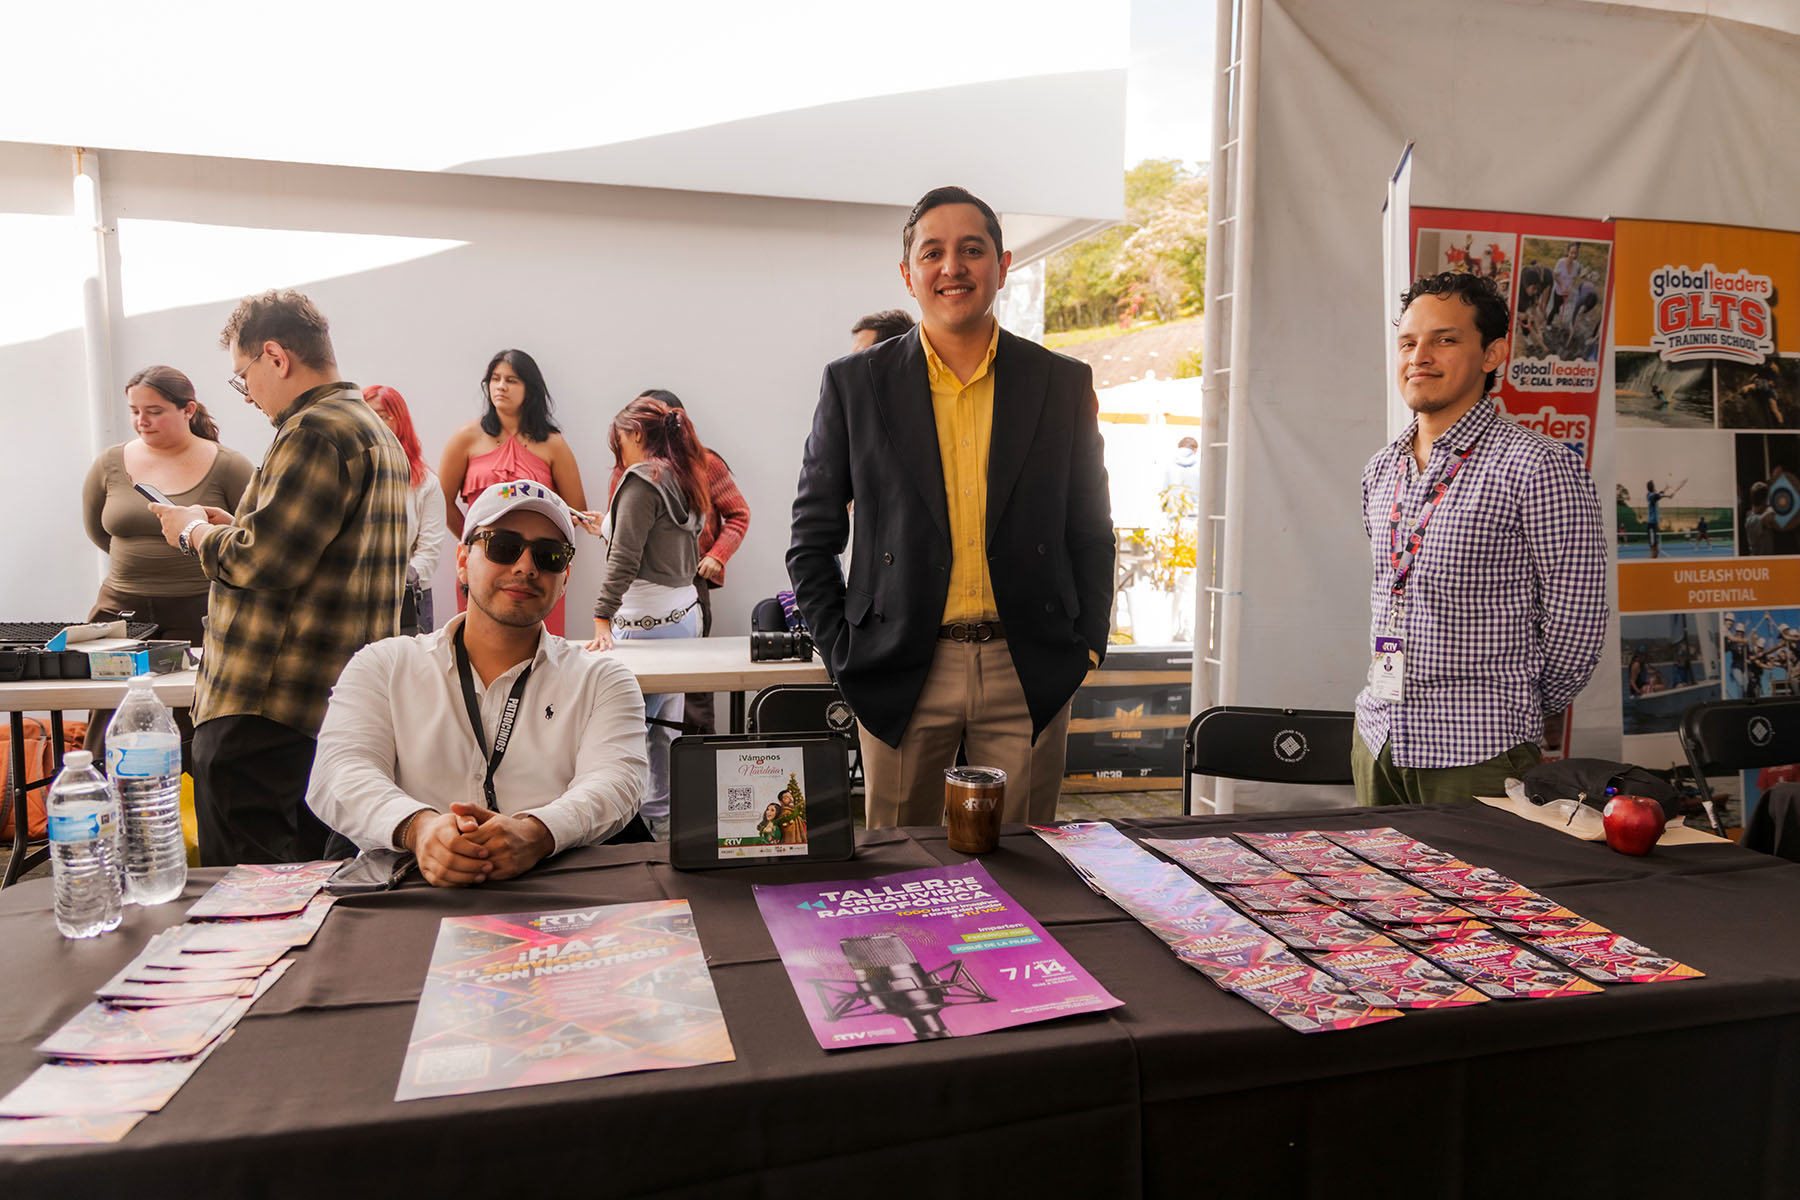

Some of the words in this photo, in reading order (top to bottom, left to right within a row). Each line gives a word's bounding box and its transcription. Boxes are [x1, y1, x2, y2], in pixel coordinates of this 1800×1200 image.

[1658, 291, 1768, 340] GLTS
[1668, 334, 1718, 348] TRAINING
[1720, 334, 1758, 351] SCHOOL
[1673, 568, 1734, 584] UNLEASH
[1735, 567, 1770, 581] YOUR
[1688, 588, 1758, 603] POTENTIAL
[495, 697, 520, 753] PATROCINIOS
[819, 878, 948, 902] TALLER
[948, 876, 979, 888] DE
[839, 884, 983, 908] CREATIVIDAD
[817, 890, 992, 919] RADIOFÓNICA
[896, 908, 931, 917] TODO
[981, 905, 1008, 914] VOZ
[540, 911, 601, 926] RTV
[455, 969, 480, 979] EL
[482, 951, 593, 976] SERVICIO
[596, 937, 683, 957] SOCIAL
[518, 933, 620, 962] ¡HAZ
[475, 968, 530, 985] CON
[534, 946, 669, 976] NOSOTROS!
[999, 967, 1017, 980] 7
[1033, 960, 1066, 975] 14
